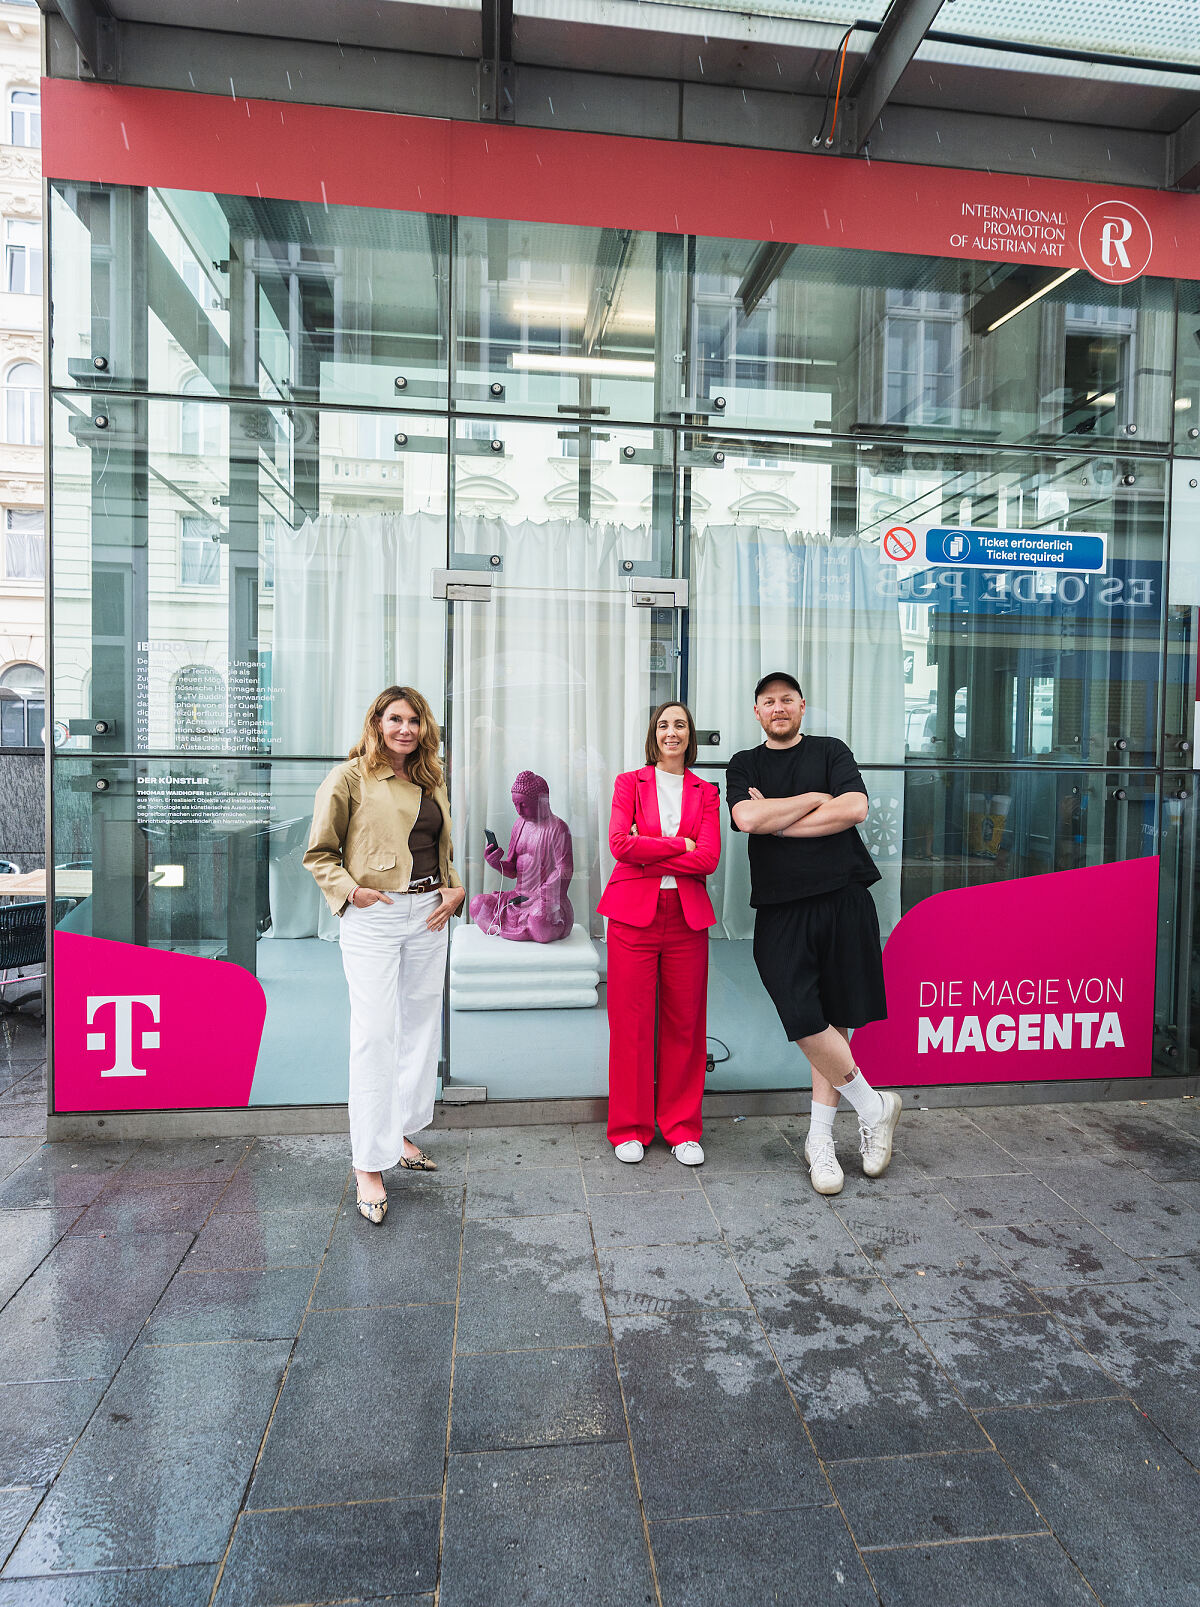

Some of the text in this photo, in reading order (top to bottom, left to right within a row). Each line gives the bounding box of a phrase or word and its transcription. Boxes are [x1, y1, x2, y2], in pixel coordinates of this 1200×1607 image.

[961, 202, 1066, 226] INTERNATIONAL
[983, 221, 1066, 241] PROMOTION
[949, 234, 1065, 257] OF AUSTRIAN ART
[977, 536, 1073, 551] Ticket erforderlich
[986, 549, 1064, 563] Ticket required
[233, 660, 266, 668] Umgang
[192, 668, 238, 676] Technogie
[204, 676, 260, 684] Möglchkeiten!
[158, 776, 210, 784] KÜNSTLER
[919, 977, 1124, 1008] DIE MAGIE VON
[917, 1011, 1126, 1054] MAGENTA
